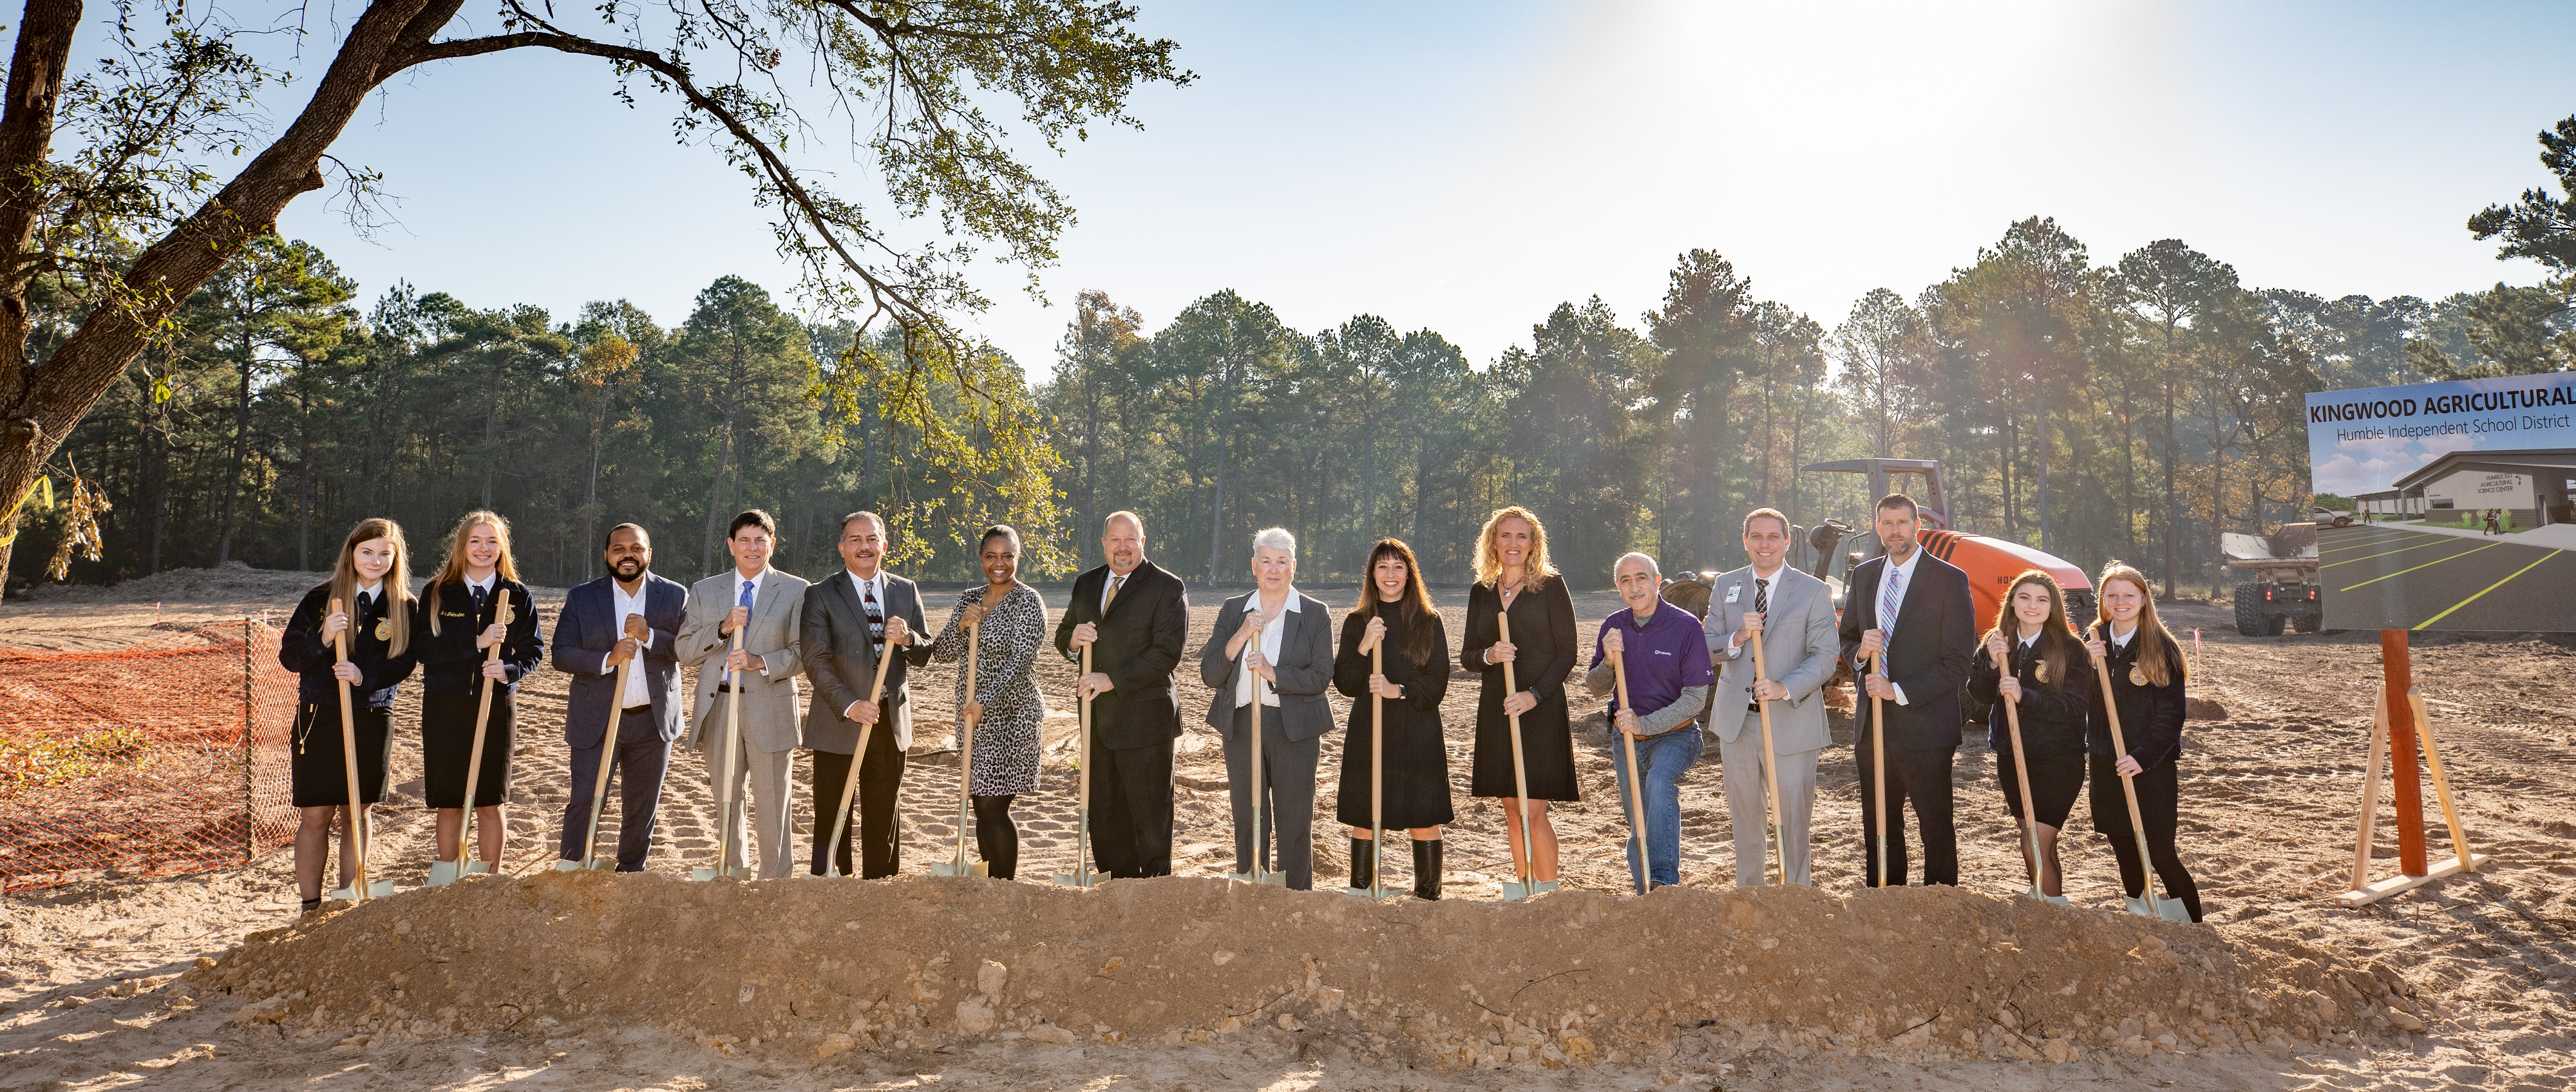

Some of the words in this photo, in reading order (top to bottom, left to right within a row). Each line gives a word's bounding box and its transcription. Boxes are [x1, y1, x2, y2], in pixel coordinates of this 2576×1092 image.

[2310, 399, 2416, 423] KINGWOOD
[2423, 386, 2576, 415] AGRICULTURAL
[2337, 425, 2384, 441] Humble
[2388, 420, 2468, 440] Independent
[2473, 416, 2517, 433] School
[2522, 413, 2570, 429] District
